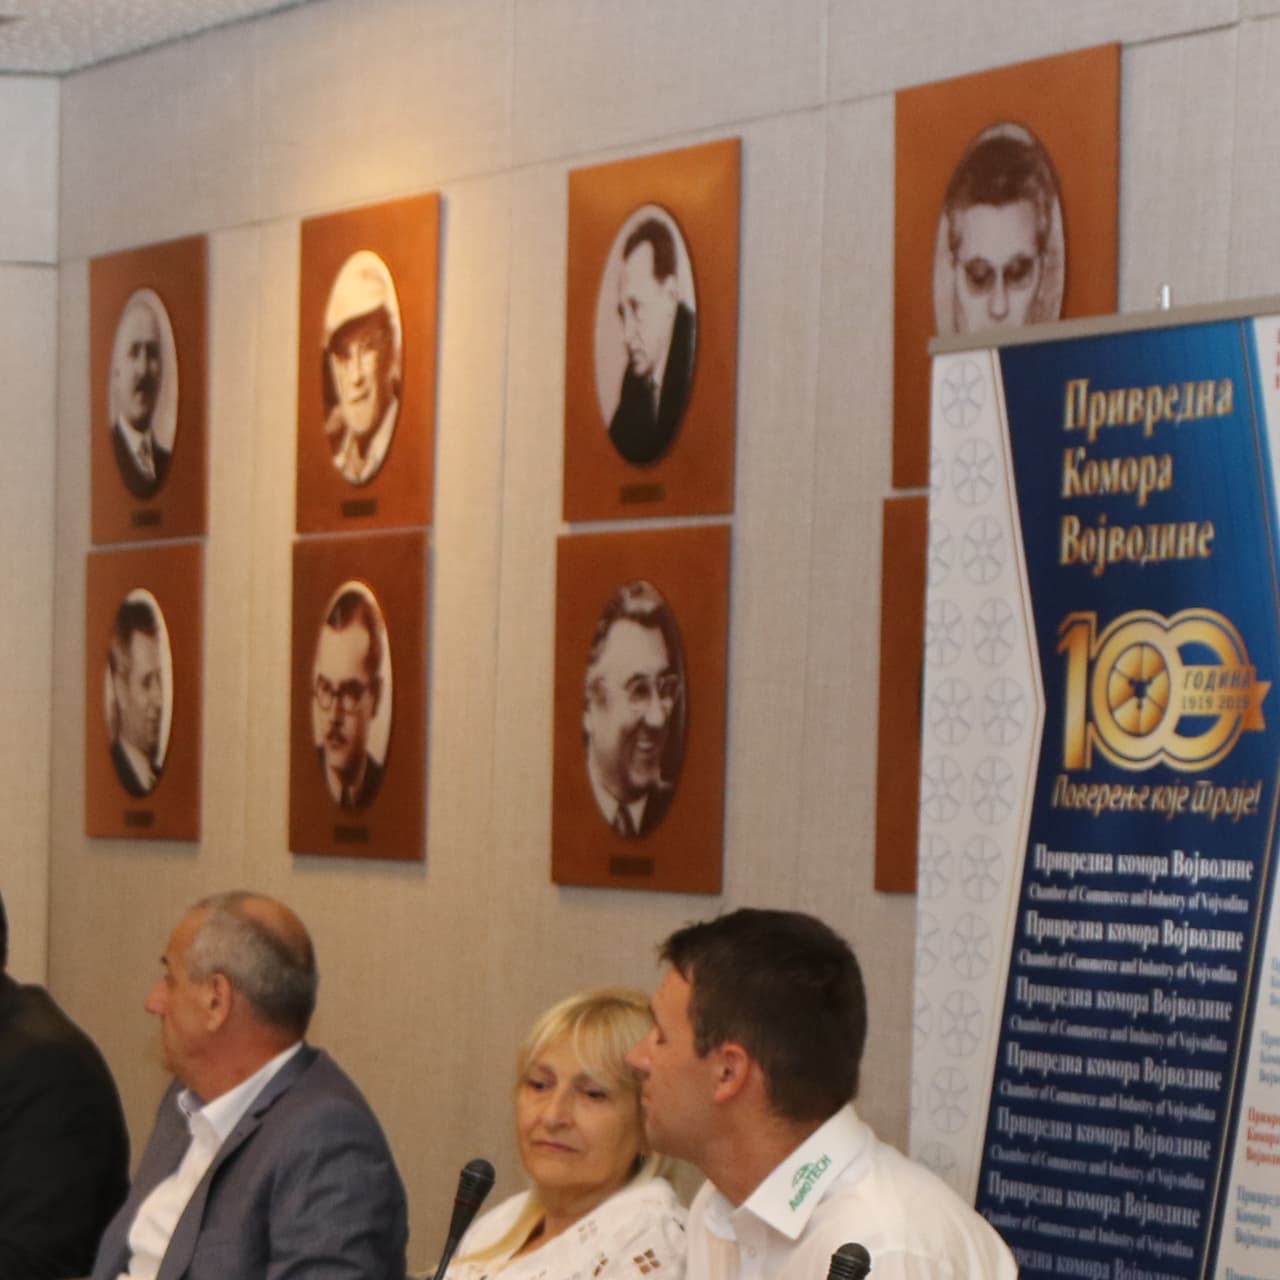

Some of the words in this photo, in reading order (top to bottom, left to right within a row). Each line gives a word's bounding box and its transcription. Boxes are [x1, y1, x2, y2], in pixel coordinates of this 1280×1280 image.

[1064, 378, 1233, 442] Привредна
[1062, 446, 1173, 507] Комора
[1059, 513, 1215, 577] Војводине
[1057, 607, 1250, 772] 100
[1183, 671, 1250, 692] ГОДИНА
[1052, 774, 1149, 818] Поверење
[1151, 777, 1189, 821] које
[1035, 843, 1113, 879] Привредна
[1118, 853, 1169, 883] комора
[1173, 850, 1254, 884] Војводине
[1025, 910, 1103, 945] Привредна
[1108, 923, 1159, 952] комора
[1162, 918, 1244, 955] Војводине
[1016, 976, 1092, 1012] Привредна
[1097, 989, 1149, 1019] комора
[1153, 987, 1233, 1023] Војводине
[1006, 1041, 1083, 1075] Привредна
[1087, 1056, 1139, 1087] комора
[1144, 1056, 1223, 1091] Војводине
